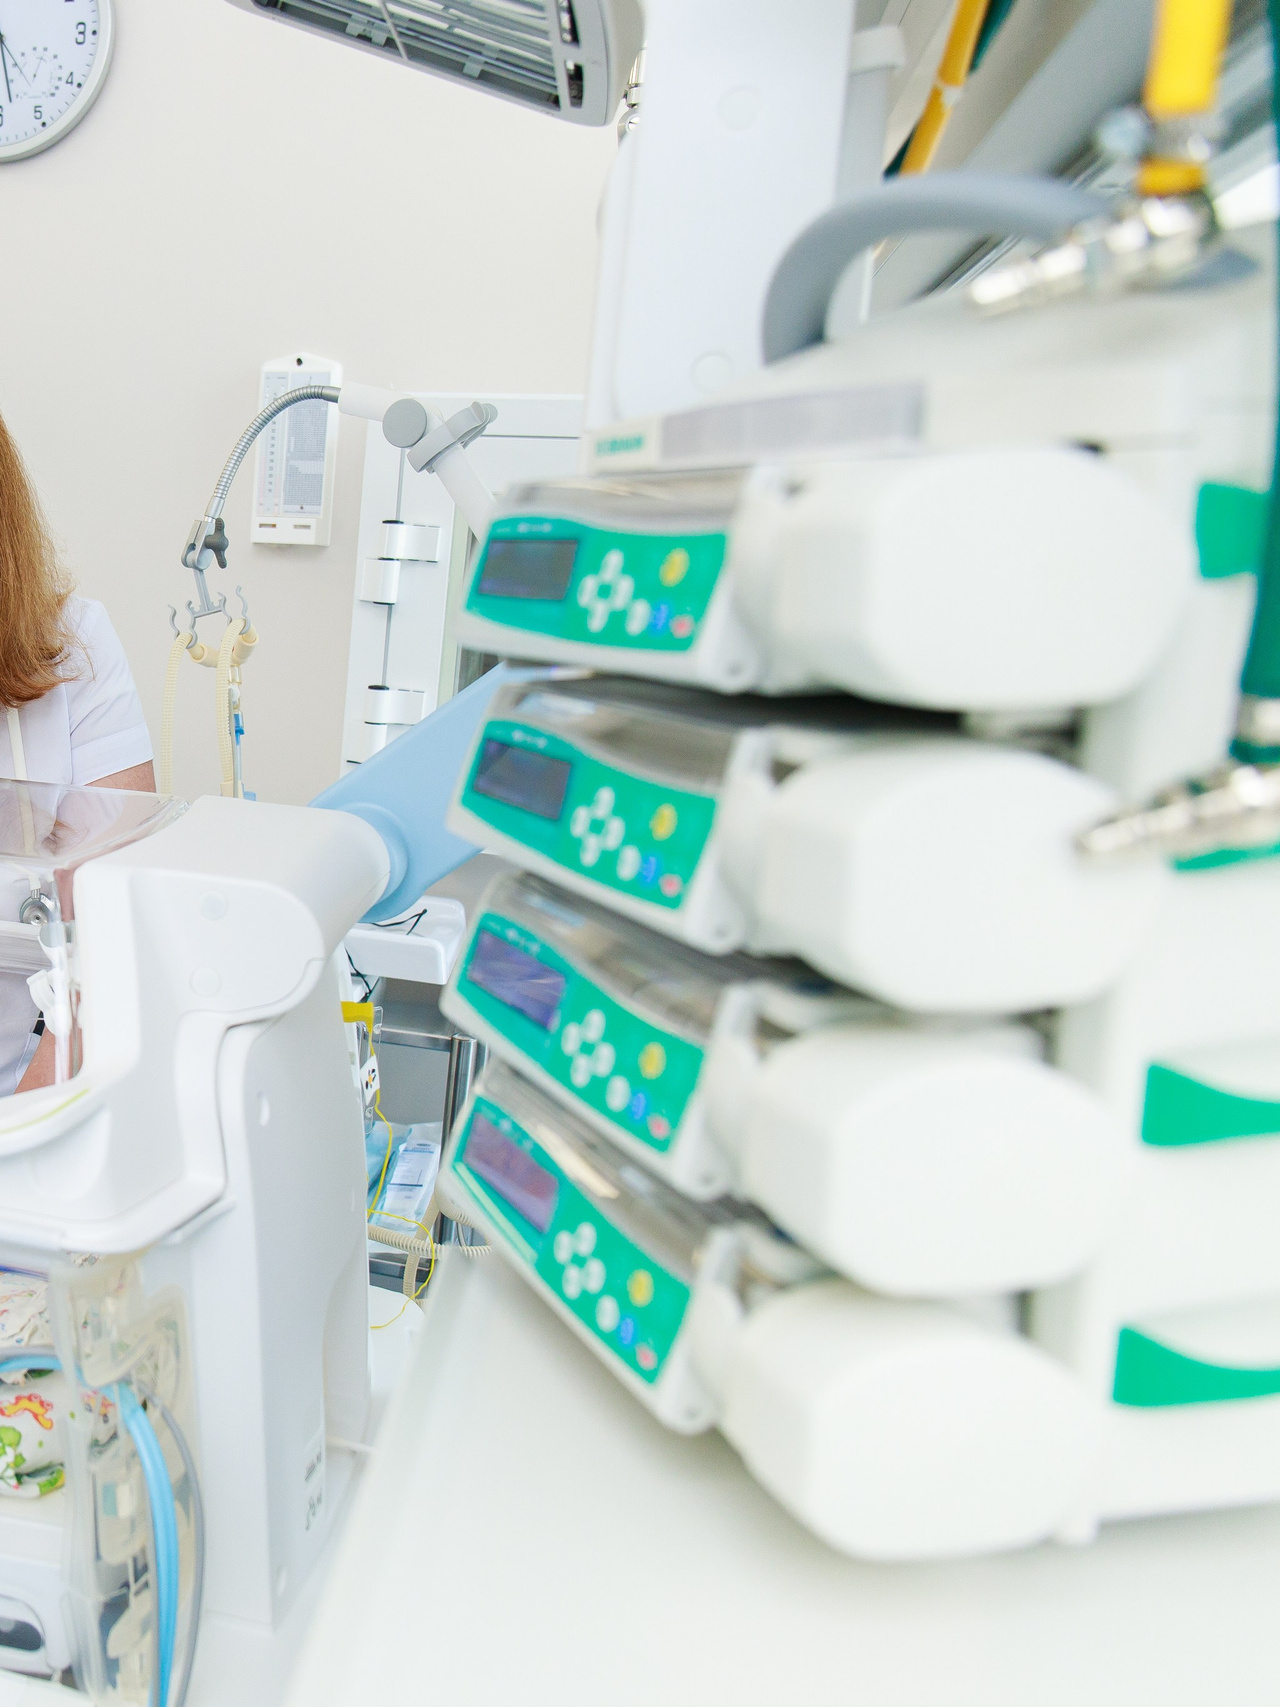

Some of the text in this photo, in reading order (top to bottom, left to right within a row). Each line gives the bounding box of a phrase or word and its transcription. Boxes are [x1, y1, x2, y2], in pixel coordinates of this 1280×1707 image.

[75, 21, 87, 45] 3
[65, 71, 74, 86] 4
[34, 105, 43, 120] 5
